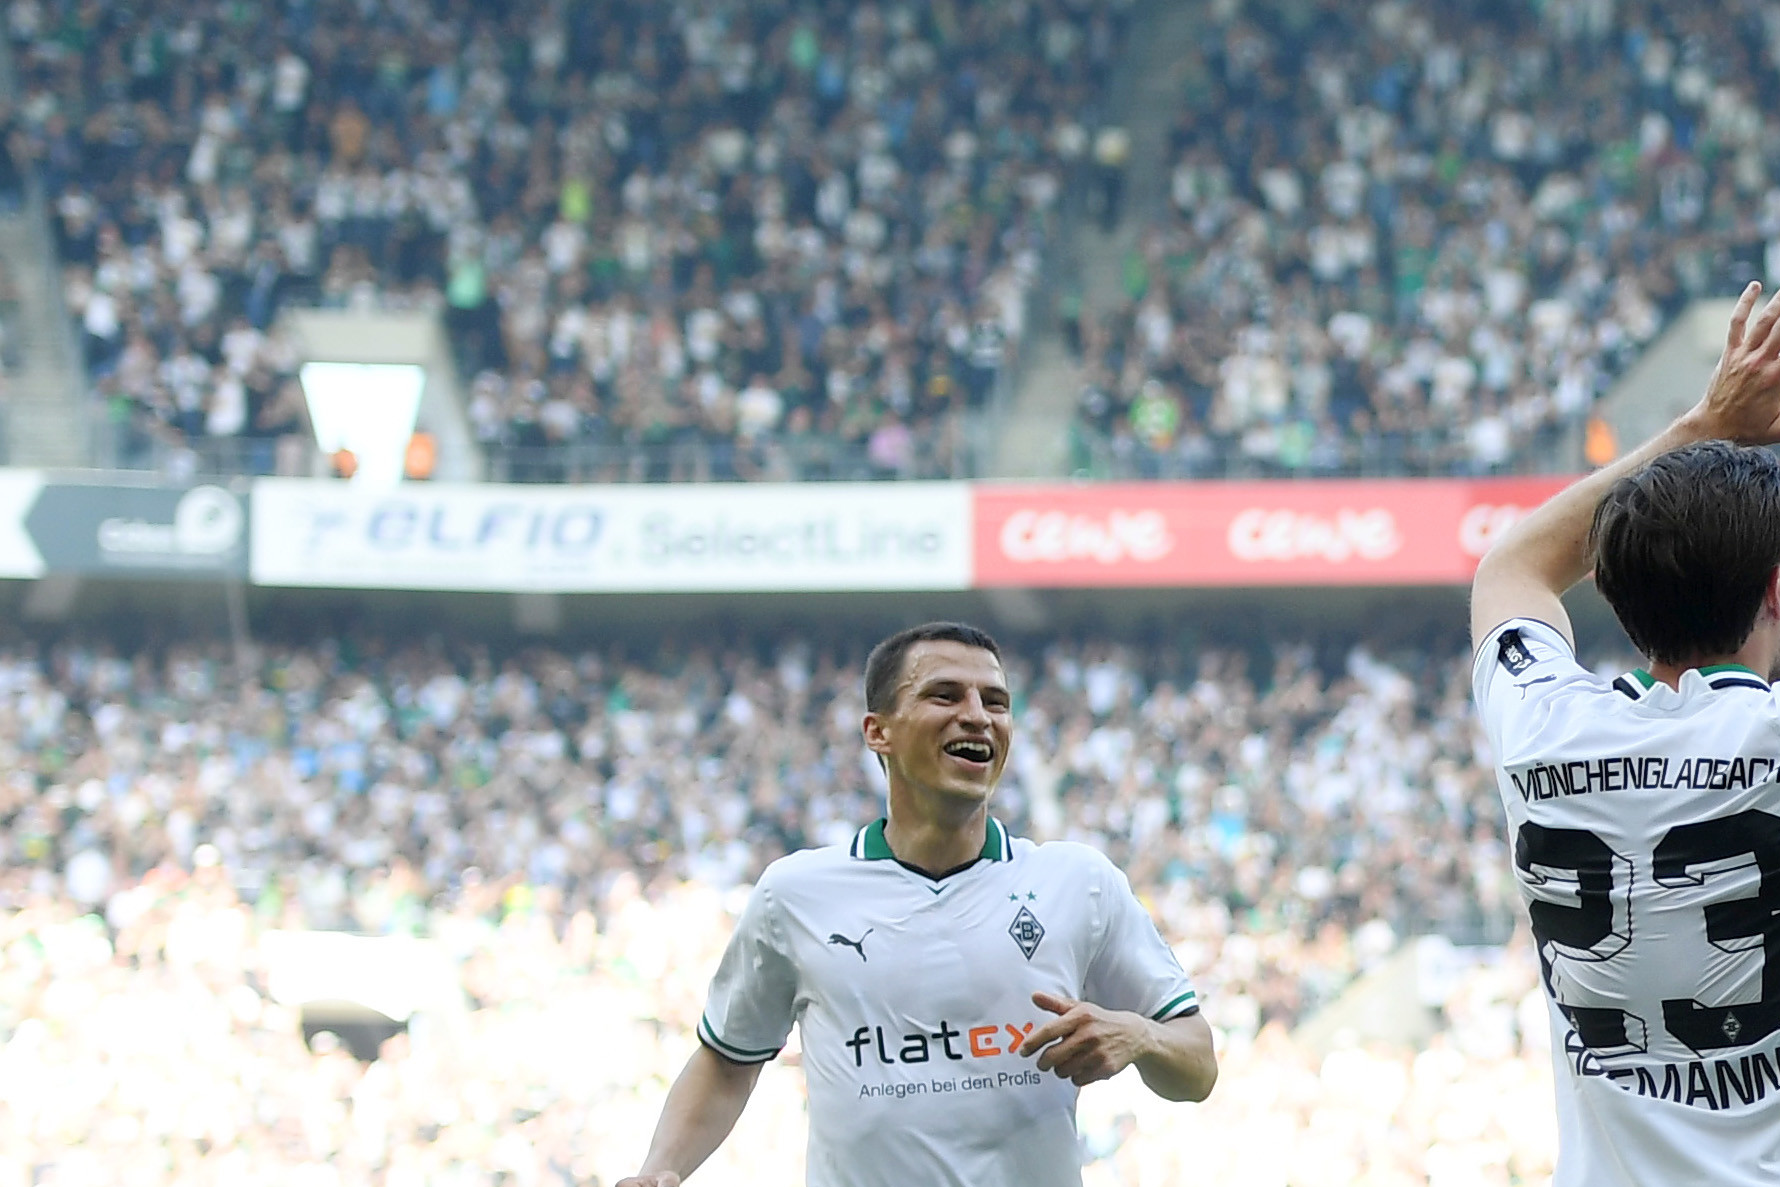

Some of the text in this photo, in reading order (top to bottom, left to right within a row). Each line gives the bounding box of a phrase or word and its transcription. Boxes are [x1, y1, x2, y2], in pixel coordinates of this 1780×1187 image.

[858, 1069, 1042, 1099] Anlegen bei den Profis
